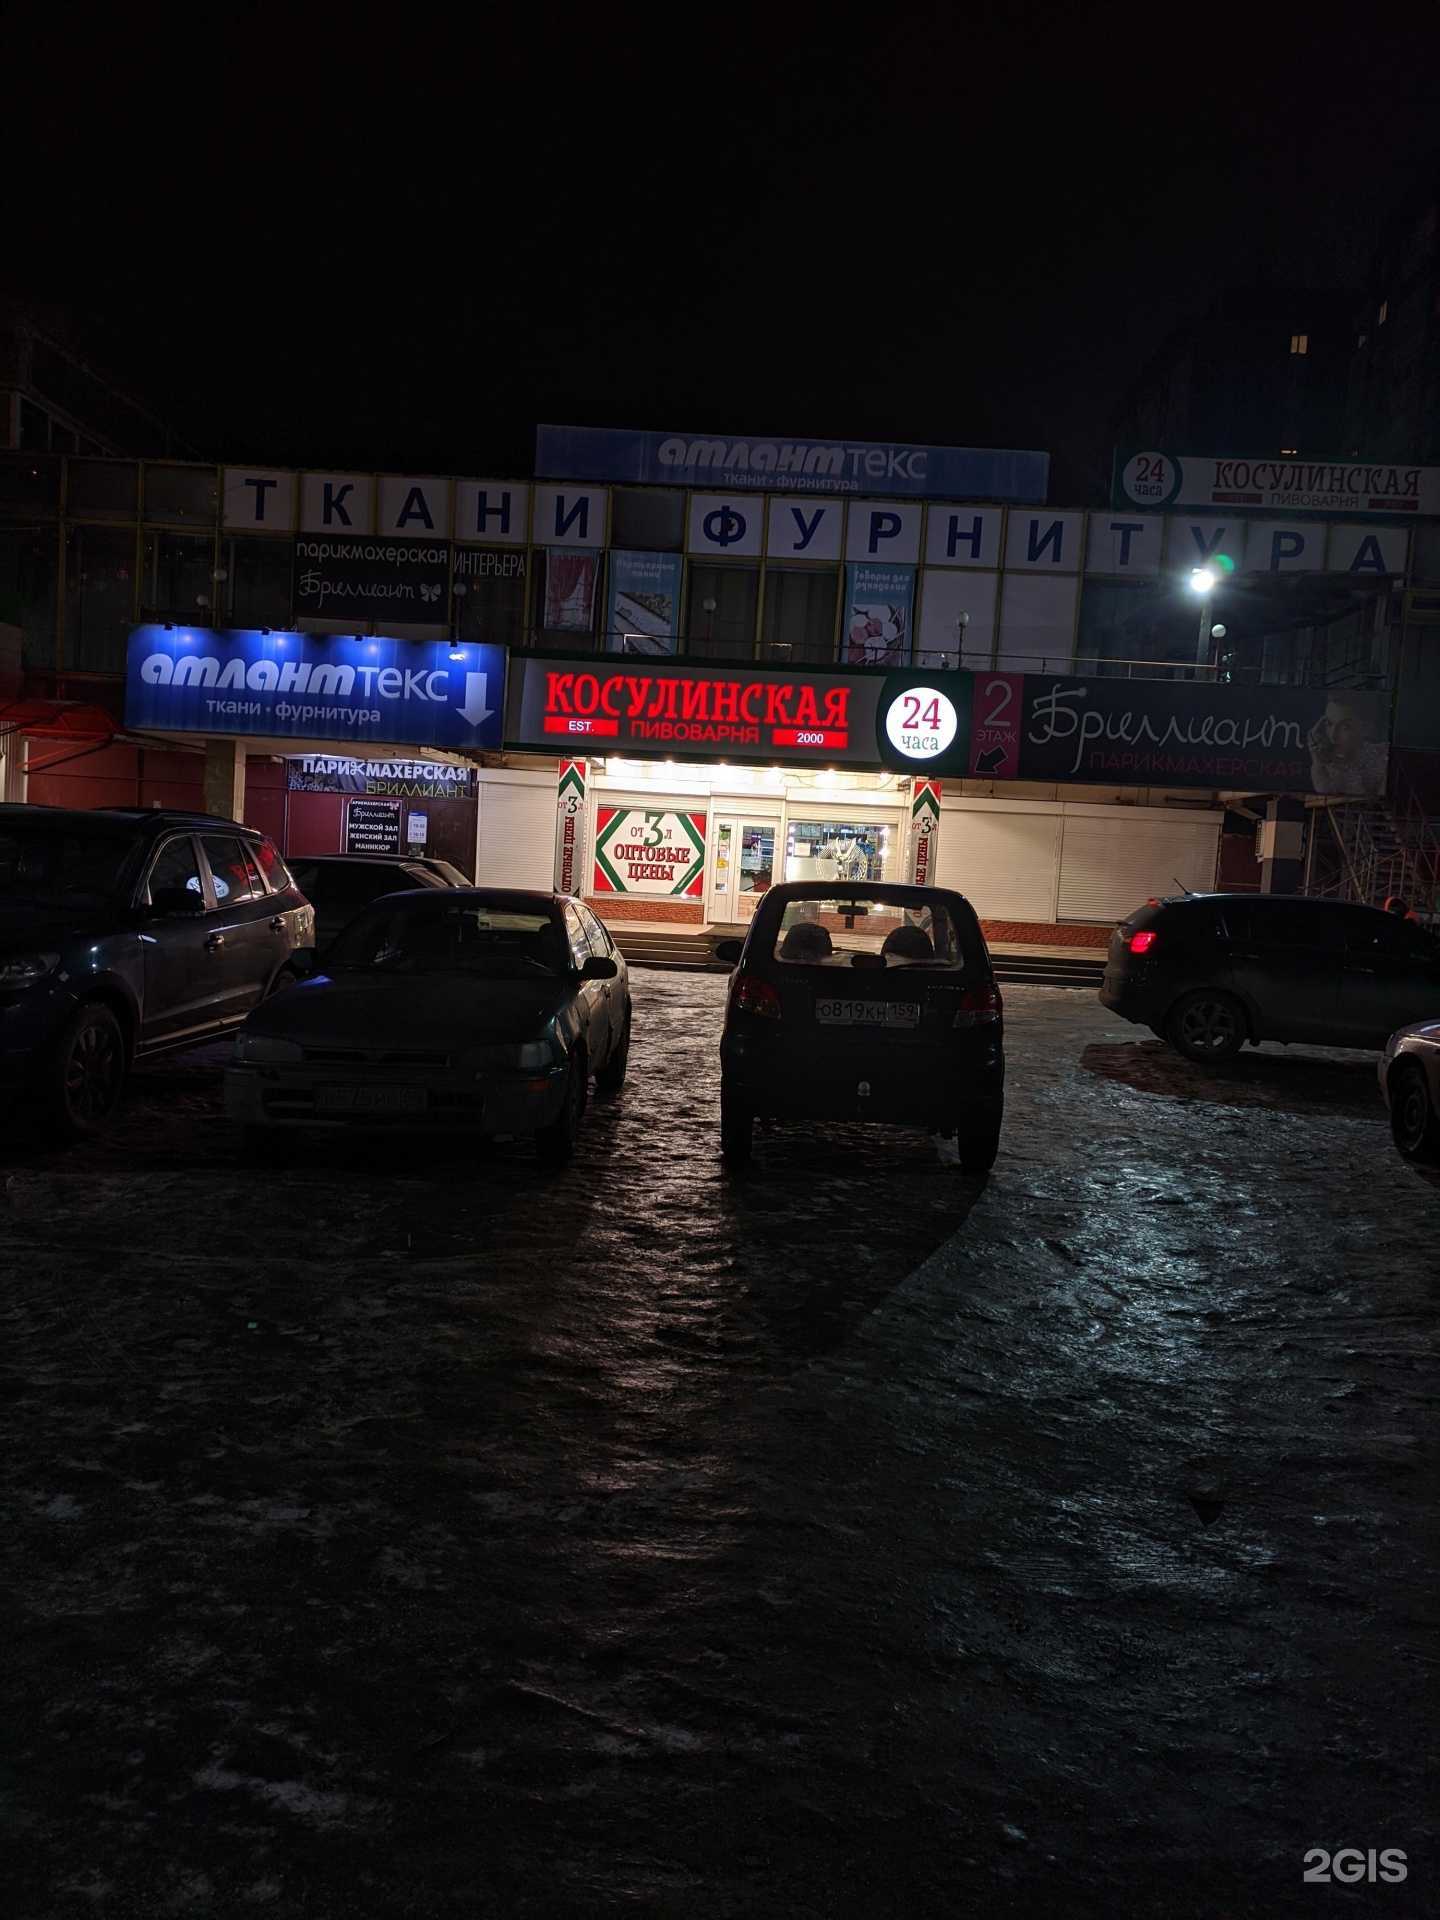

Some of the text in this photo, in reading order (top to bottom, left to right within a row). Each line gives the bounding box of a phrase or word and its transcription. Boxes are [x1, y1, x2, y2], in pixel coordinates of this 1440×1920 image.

[1136, 457, 1164, 483] 24
[1212, 461, 1421, 496] КОСУЛИНСКАЯ
[722, 472, 859, 492] ткани фурнитура
[1133, 483, 1163, 497] часа
[245, 479, 589, 538] ТКАНИ
[1270, 493, 1360, 508] ПИВОВАРНЯ
[297, 542, 448, 567] парикмахерская
[453, 552, 526, 577] ИНТЕРЬЕРА
[298, 569, 417, 607] Бриллиант
[544, 672, 850, 727] КОСУЛИНСКАЯ
[984, 679, 1013, 727] 2
[206, 698, 381, 726] ткани фурнитура
[902, 696, 942, 730] 24
[568, 719, 595, 733] EST.
[630, 720, 760, 744] ПИВОВАРНЯ
[976, 728, 1017, 743] ЭТАЖ
[1028, 683, 1304, 774] Бриллиант
[796, 732, 824, 745] 2000
[901, 735, 939, 751] часа
[1090, 752, 1300, 778] ПАРИКМАХЕРСКАЯ
[366, 781, 467, 798] БРИЛЛИАНТ
[567, 796, 578, 814] 3
[349, 823, 383, 831] МУЖСКОЙ
[630, 811, 672, 846] от 3 л
[921, 816, 932, 834] 3
[349, 833, 383, 841] ЖЕНСКИЙ
[355, 843, 391, 851] МАНИКЮР
[561, 816, 575, 893] ОПТОВЫЕ ЦЕНЫ
[613, 844, 691, 864] ОПТОВЫЕ
[627, 862, 675, 882] ЦЕНЫ
